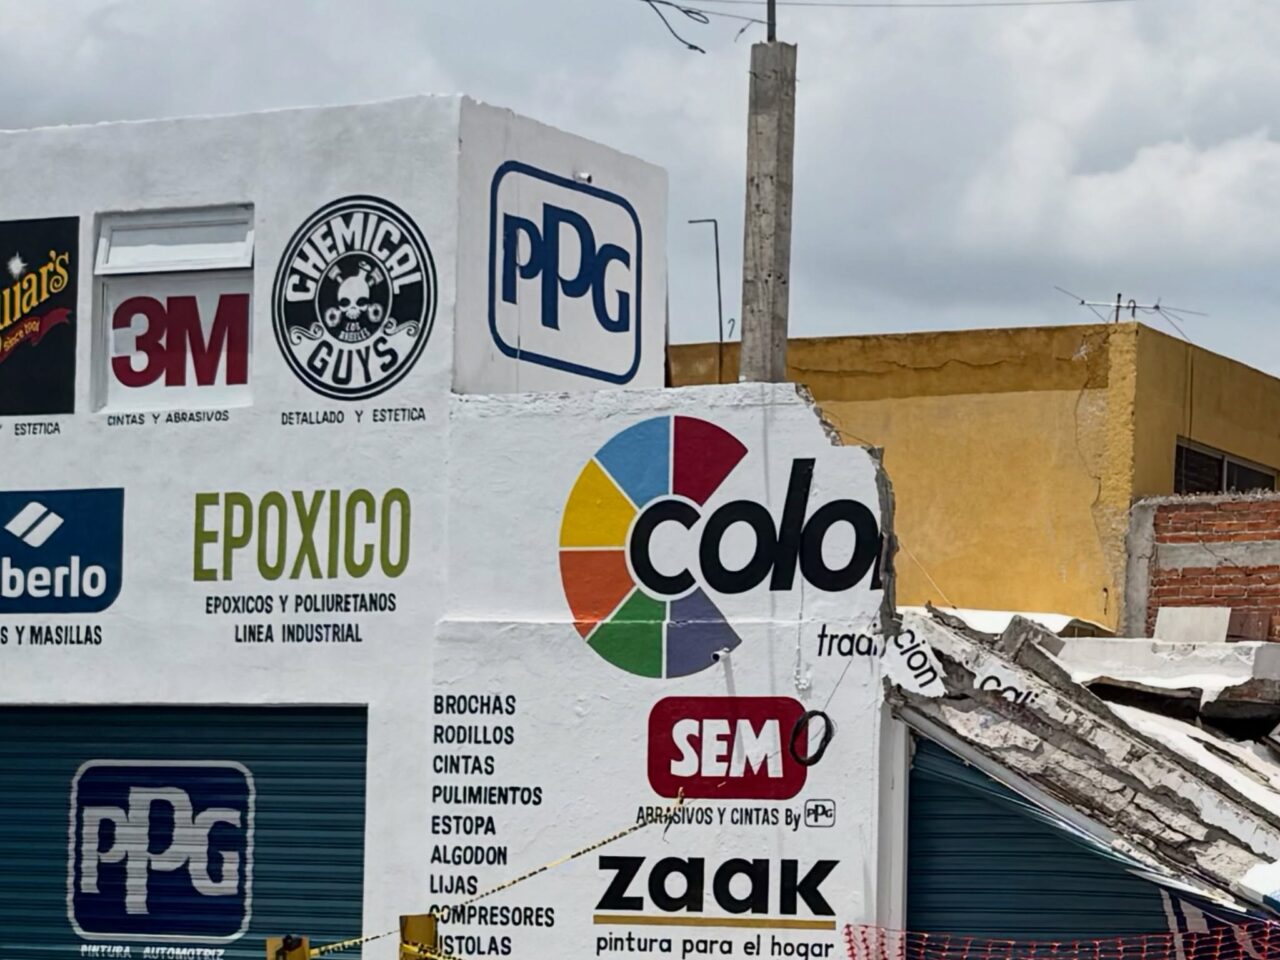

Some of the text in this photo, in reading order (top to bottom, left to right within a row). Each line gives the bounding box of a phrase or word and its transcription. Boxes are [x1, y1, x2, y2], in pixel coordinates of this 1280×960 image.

[286, 212, 423, 302] CHEMICAL
[502, 202, 631, 333] PPG
[111, 293, 250, 388] 3M
[307, 337, 399, 386] GUYS
[107, 409, 229, 426] CINTAS Y ABRASIVOS
[281, 407, 426, 426] DETALLADO Y ESTETICA
[14, 421, 61, 436] ESTETICA
[194, 487, 411, 582] EPOXICO
[1, 555, 107, 598] berlo
[205, 592, 397, 615] EPOXICOS Y POLIURETANOS
[15, 625, 25, 645] Y
[30, 625, 103, 645] MASILLAS
[234, 623, 363, 643] LINEA INDUSTRIAL
[433, 694, 517, 716] BROCHAS
[433, 724, 515, 746] RODILLOS
[670, 718, 784, 778] SEM
[432, 754, 495, 776] CINTAS
[432, 785, 543, 806] PULIMIENTOS
[431, 815, 497, 836] ESTOPA
[635, 804, 833, 832] ABRASIVOS Y CINTAS By PPG
[80, 787, 242, 915] PPG
[430, 844, 508, 866] ALGODON
[429, 874, 479, 896] LIJAS
[594, 855, 841, 917] zaak
[428, 903, 555, 928] COMPRESORES
[81, 944, 132, 959] PINTURA
[438, 935, 512, 956] ISTOLAS
[596, 931, 672, 957] pintura
[681, 938, 733, 960] para
[743, 933, 761, 956] el
